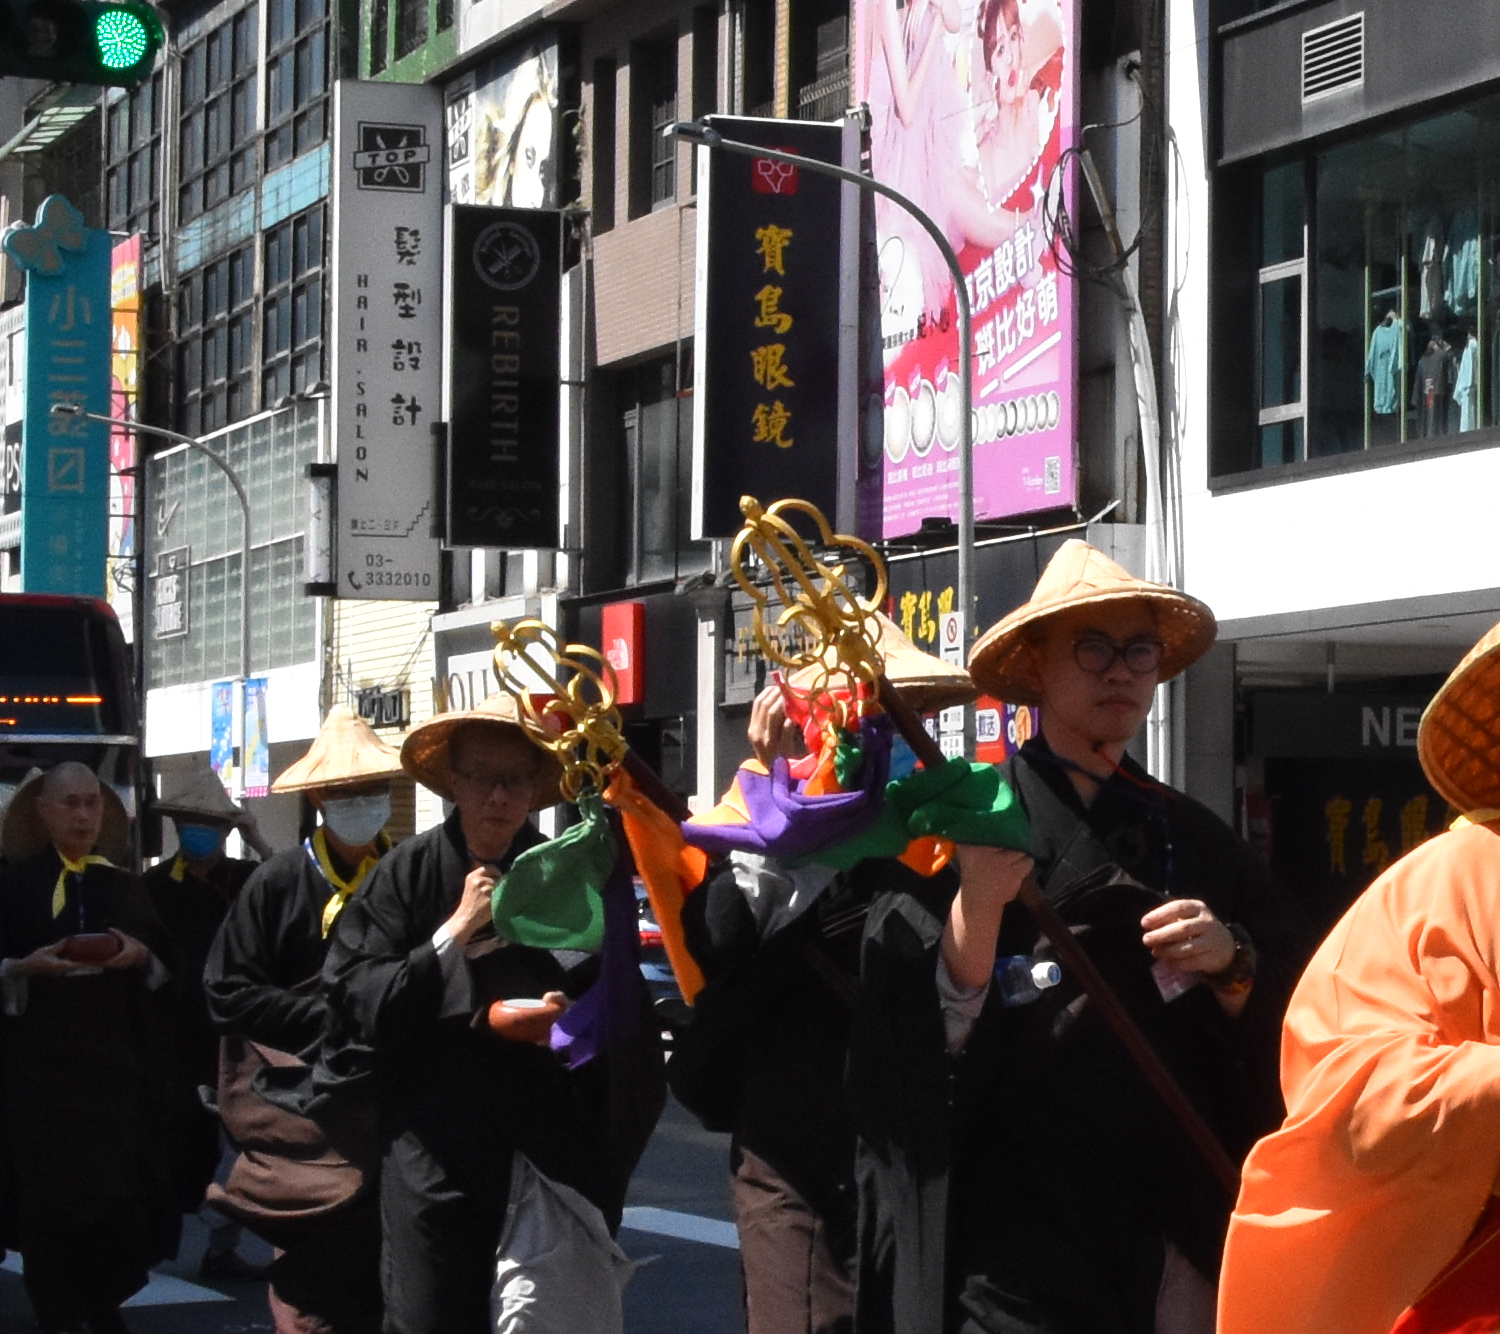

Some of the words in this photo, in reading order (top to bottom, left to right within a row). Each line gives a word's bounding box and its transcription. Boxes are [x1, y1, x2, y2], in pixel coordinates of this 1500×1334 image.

[367, 149, 417, 166] TOP
[357, 274, 369, 353] HAIR
[391, 226, 422, 426] 髮型設計
[750, 224, 796, 450] 寶島眼鏡
[490, 305, 522, 462] REBIRTH
[355, 381, 369, 483] SALON
[365, 572, 431, 587] 3332010
[366, 554, 394, 568] 03-
[1361, 706, 1422, 747] NE
